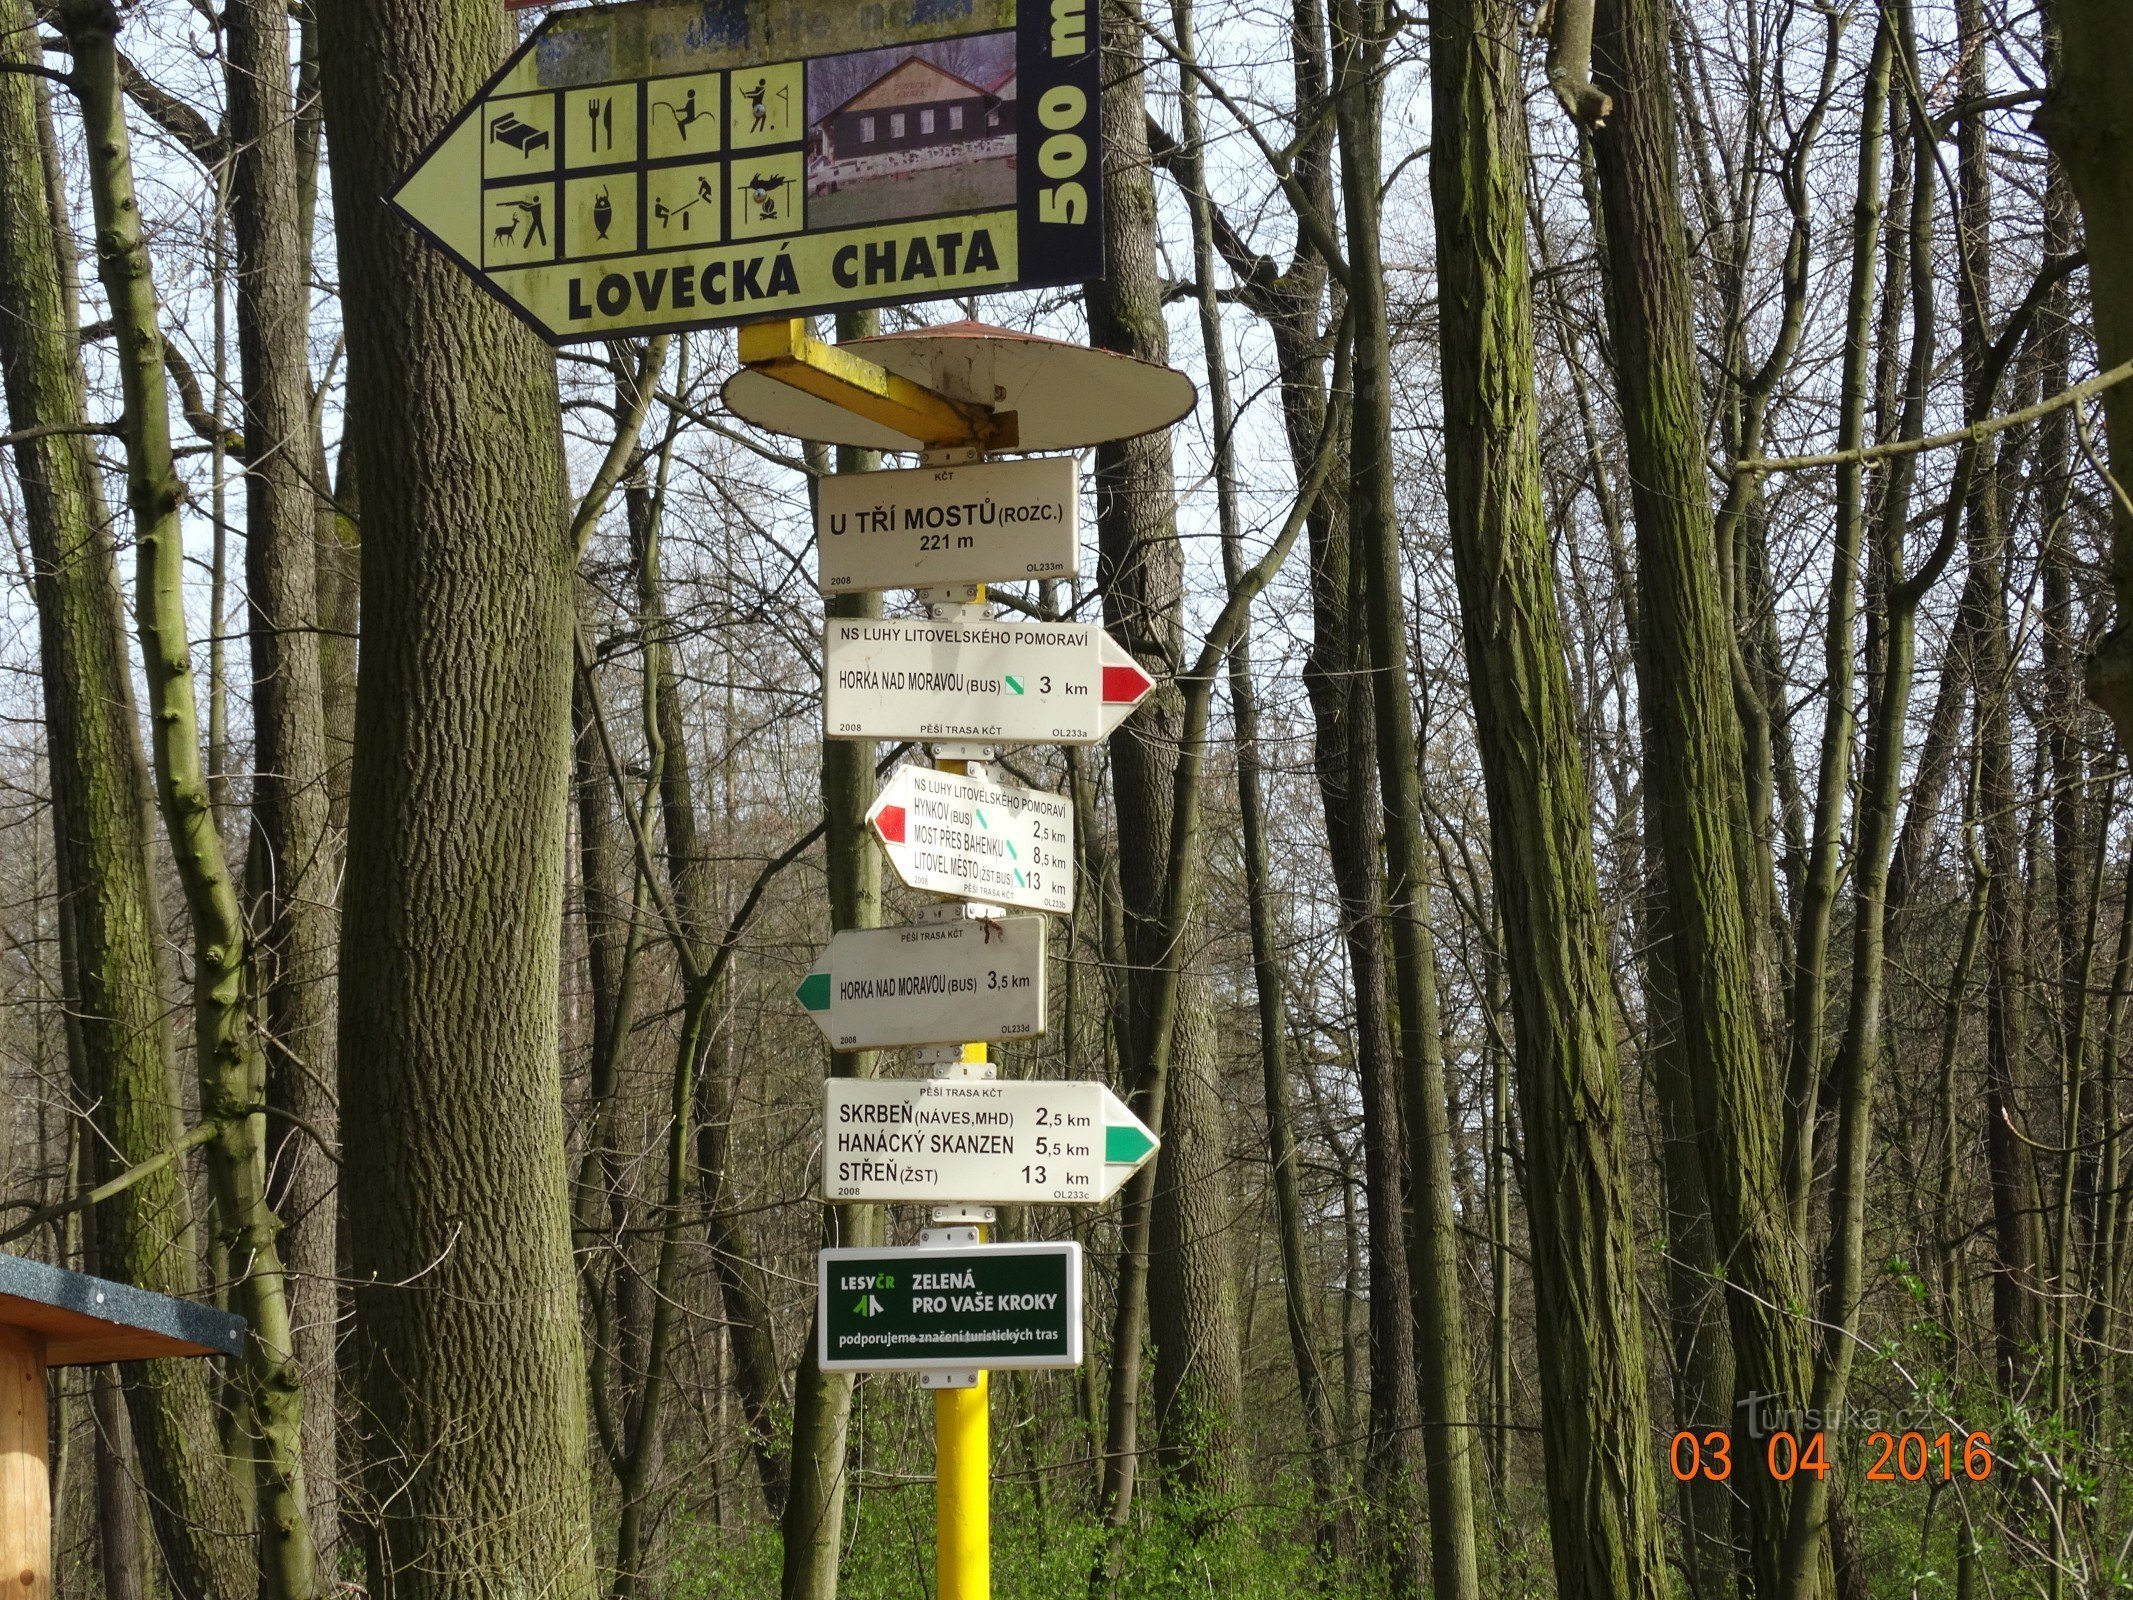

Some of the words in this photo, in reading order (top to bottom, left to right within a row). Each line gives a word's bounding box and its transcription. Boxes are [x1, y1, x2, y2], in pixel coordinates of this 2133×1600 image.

[1050, 0, 1086, 58] m
[1038, 85, 1088, 225] 500
[568, 241, 800, 321] LOVECKÁ
[831, 229, 1000, 290] CHATA
[934, 470, 954, 482] KČT
[830, 512, 847, 536] U
[855, 506, 896, 533] TŘÍ
[919, 534, 950, 551] 221
[957, 535, 974, 549] m
[1026, 562, 1064, 573] OL233m
[830, 575, 852, 586] 2008
[840, 627, 860, 641] NS
[864, 628, 901, 642] LUHY
[905, 627, 1011, 645] LITOVELSKÉHO
[1015, 630, 1089, 647] POMORAVÍ
[839, 670, 879, 690] HORKA
[881, 671, 905, 690] NAD
[908, 672, 964, 692] MORAVOU
[966, 679, 1001, 696] (BUS)
[1039, 675, 1052, 695] 3
[1065, 682, 1088, 696] km
[839, 723, 862, 732] 2008
[920, 723, 943, 735] PĚŠÍ
[945, 725, 979, 736] TRASA
[981, 724, 1002, 736] KČT
[1052, 728, 1088, 738] OL233a
[914, 778, 927, 792] NS
[928, 781, 952, 797] LUHY
[954, 785, 1020, 810] LITOVELSKÉHO
[1021, 799, 1066, 819] POMORAVÍ
[914, 797, 949, 821] HYNKOV
[950, 810, 973, 828] (BUS)
[1033, 820, 1049, 841] 2,5
[1051, 829, 1066, 844] km
[914, 824, 938, 846] MOST
[940, 826, 962, 850] PŘES
[964, 836, 1004, 858] BAHENKU
[1033, 846, 1049, 867] 8,5
[1051, 855, 1066, 870] km
[914, 852, 949, 875] LITOVEL
[950, 854, 979, 880] MĚSTO
[1025, 870, 1041, 890] 13
[1051, 881, 1066, 895] km
[963, 882, 979, 894] PĚŠÍ
[979, 886, 1001, 898] TRASA
[1001, 888, 1015, 899] KČT
[1044, 898, 1066, 909] OL233b
[901, 930, 919, 943] PĚŠÍ
[920, 930, 946, 942] TRASA
[947, 928, 964, 940] KČT
[840, 979, 874, 1001] HORKA
[875, 977, 896, 997] NAD
[898, 974, 946, 996] MORAVOU
[947, 976, 977, 997] (BUS)
[987, 970, 1008, 991] 3,5
[1011, 974, 1030, 989] km
[1001, 1023, 1030, 1034] OL233d
[840, 1036, 857, 1045] 2008
[919, 1086, 943, 1098] PĚŠÍ
[945, 1088, 980, 1098] TRASA
[981, 1087, 1003, 1098] KČT
[1035, 1107, 1063, 1129] 2,5
[1067, 1113, 1091, 1127] km
[838, 1130, 924, 1154] HANÁCKÝ
[930, 1135, 1014, 1155] SKANZEN
[1035, 1136, 1062, 1158] 5,5
[1066, 1143, 1090, 1157] km
[839, 1158, 898, 1182] STŘEŇ
[1021, 1165, 1047, 1185] 13
[1066, 1172, 1089, 1185] km
[838, 1187, 861, 1196] 2008
[1053, 1189, 1090, 1199] OL233c
[912, 1268, 975, 1290] ZELENÁ
[912, 1295, 948, 1314] PRO
[950, 1292, 993, 1313] VAŠE
[998, 1293, 1058, 1311] KROKY
[839, 1331, 916, 1348] podporujeme
[918, 1328, 964, 1343] značení
[965, 1327, 1034, 1343] turistických
[1036, 1328, 1059, 1341] tras
